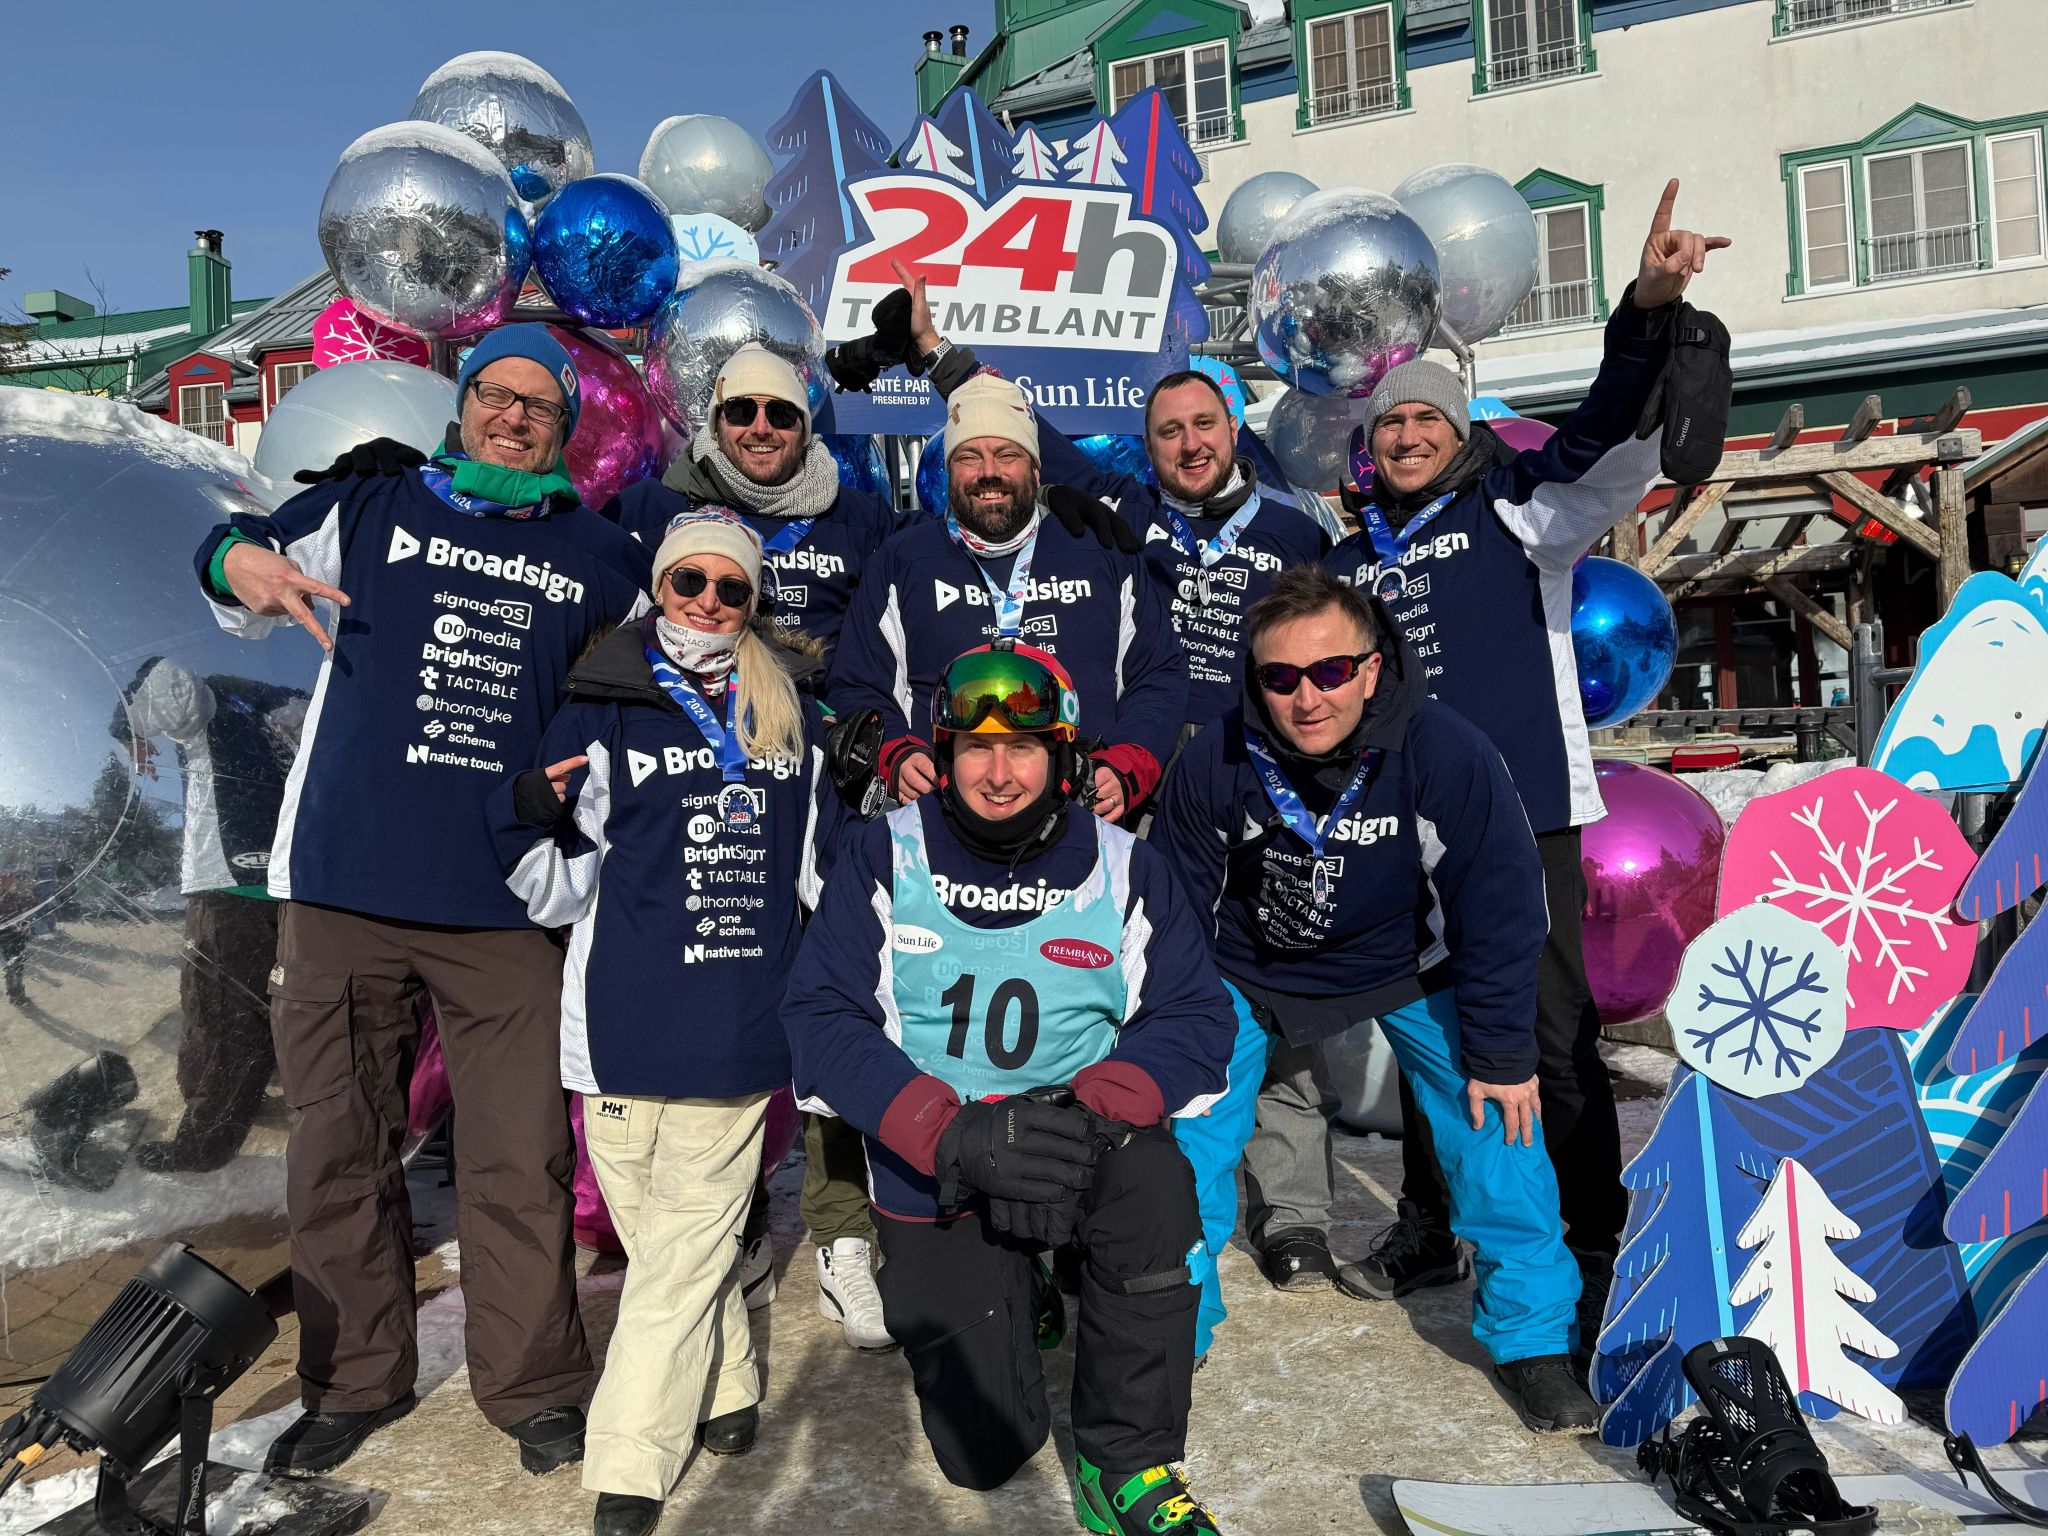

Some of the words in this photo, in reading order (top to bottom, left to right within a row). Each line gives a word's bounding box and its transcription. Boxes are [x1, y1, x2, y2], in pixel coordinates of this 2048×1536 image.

[847, 187, 1167, 299] 24h
[842, 297, 1156, 340] TMBLANT
[905, 379, 930, 393] PAR
[1015, 376, 1077, 407] Sun
[1084, 376, 1146, 407] Life
[872, 395, 918, 405] PRESENTED
[919, 397, 930, 405] BY
[449, 491, 471, 511] 2024
[1421, 502, 1443, 519] 2024
[1355, 531, 1470, 587] Brdsign
[426, 536, 585, 604] Broadsign
[964, 576, 1092, 606] Brdsign
[433, 591, 525, 621] signageOS
[982, 620, 1051, 637] siggeOS
[1187, 621, 1240, 642] TACTABLE
[422, 643, 520, 677] BrightSign
[1190, 655, 1206, 664] one
[446, 674, 519, 700] TACTABLE
[1206, 671, 1231, 684] touch
[435, 697, 513, 723] thorndyke
[686, 698, 708, 720] 2024
[450, 721, 475, 732] one
[448, 733, 497, 750] schema
[429, 751, 468, 767] native
[470, 756, 504, 773] touch
[1265, 769, 1286, 795] 2024
[1351, 765, 1370, 791] 2024
[684, 844, 763, 864] BrightSign
[708, 870, 766, 883] TACTABLE
[702, 895, 764, 911] thorndyke
[719, 915, 741, 924] one
[1271, 920, 1288, 934] one
[719, 927, 756, 936] schema
[897, 934, 916, 945] Sun
[917, 936, 937, 949] Life
[705, 945, 740, 958] native
[741, 944, 763, 957] touch
[941, 973, 1040, 1070] 10
[602, 1101, 623, 1115] HH
